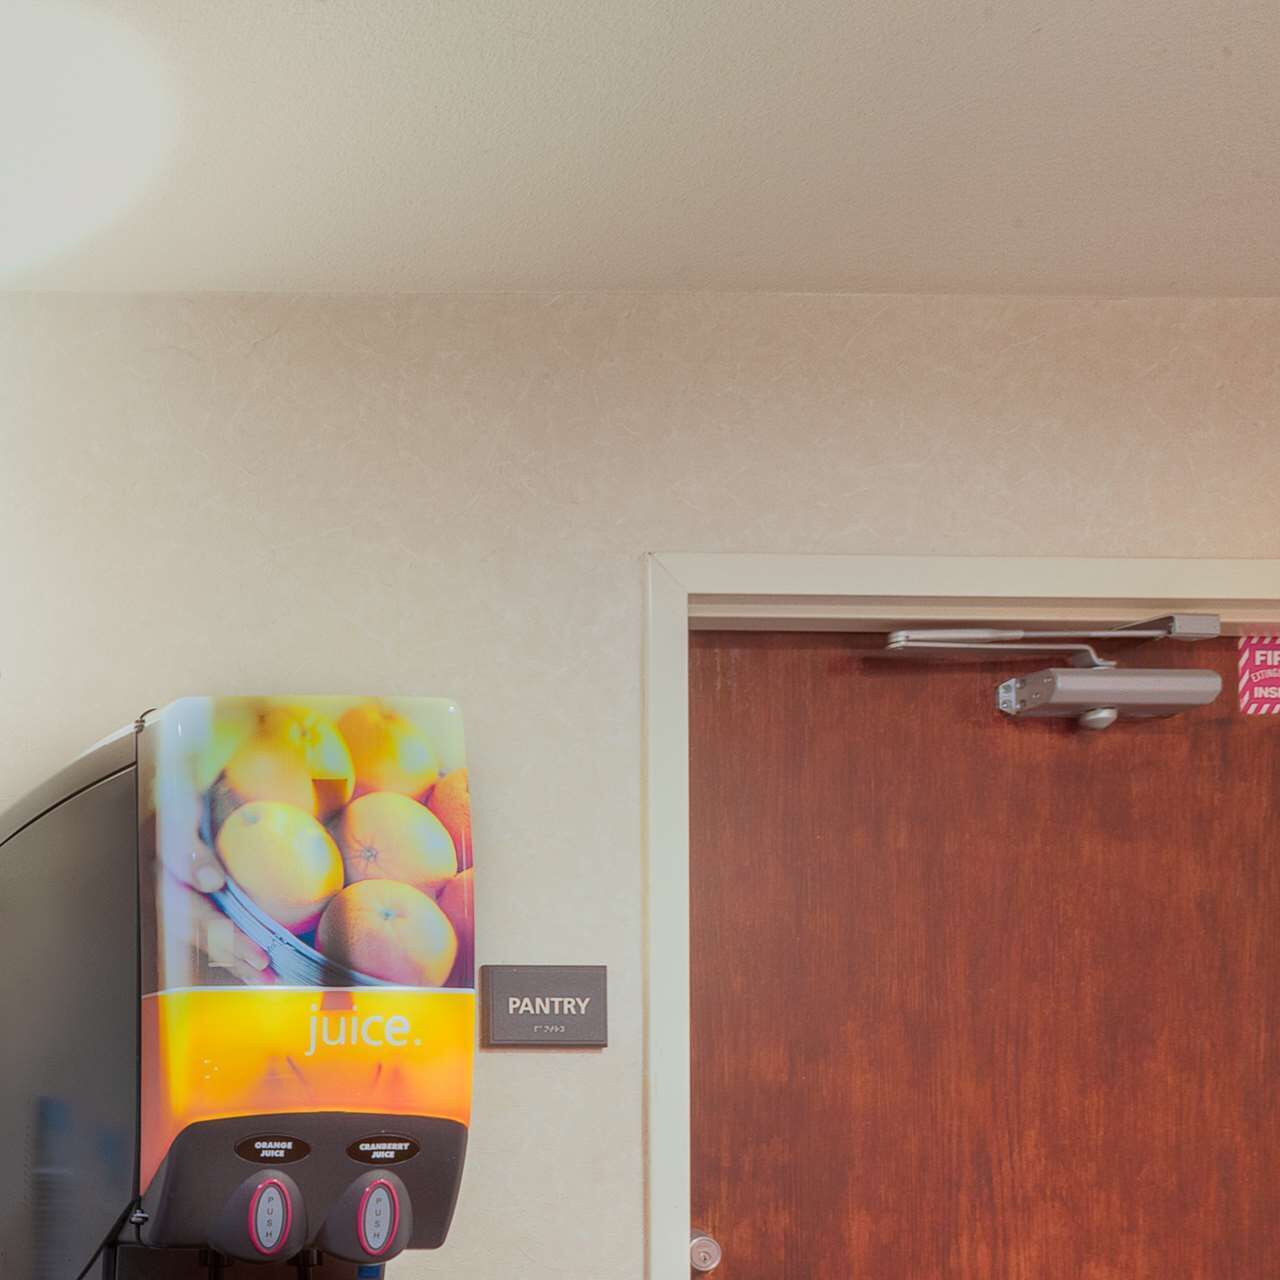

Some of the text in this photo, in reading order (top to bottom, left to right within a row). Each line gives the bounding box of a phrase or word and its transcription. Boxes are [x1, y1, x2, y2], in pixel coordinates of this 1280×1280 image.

[508, 997, 591, 1014] PANTRY
[304, 1004, 422, 1056] juice.
[254, 1141, 293, 1150] ORANGE
[359, 1142, 410, 1151] CRANBERRY
[260, 1150, 285, 1158] JUICE
[371, 1151, 395, 1159] JUICE
[265, 1196, 274, 1239] PUSH
[373, 1197, 382, 1240] PUSH
